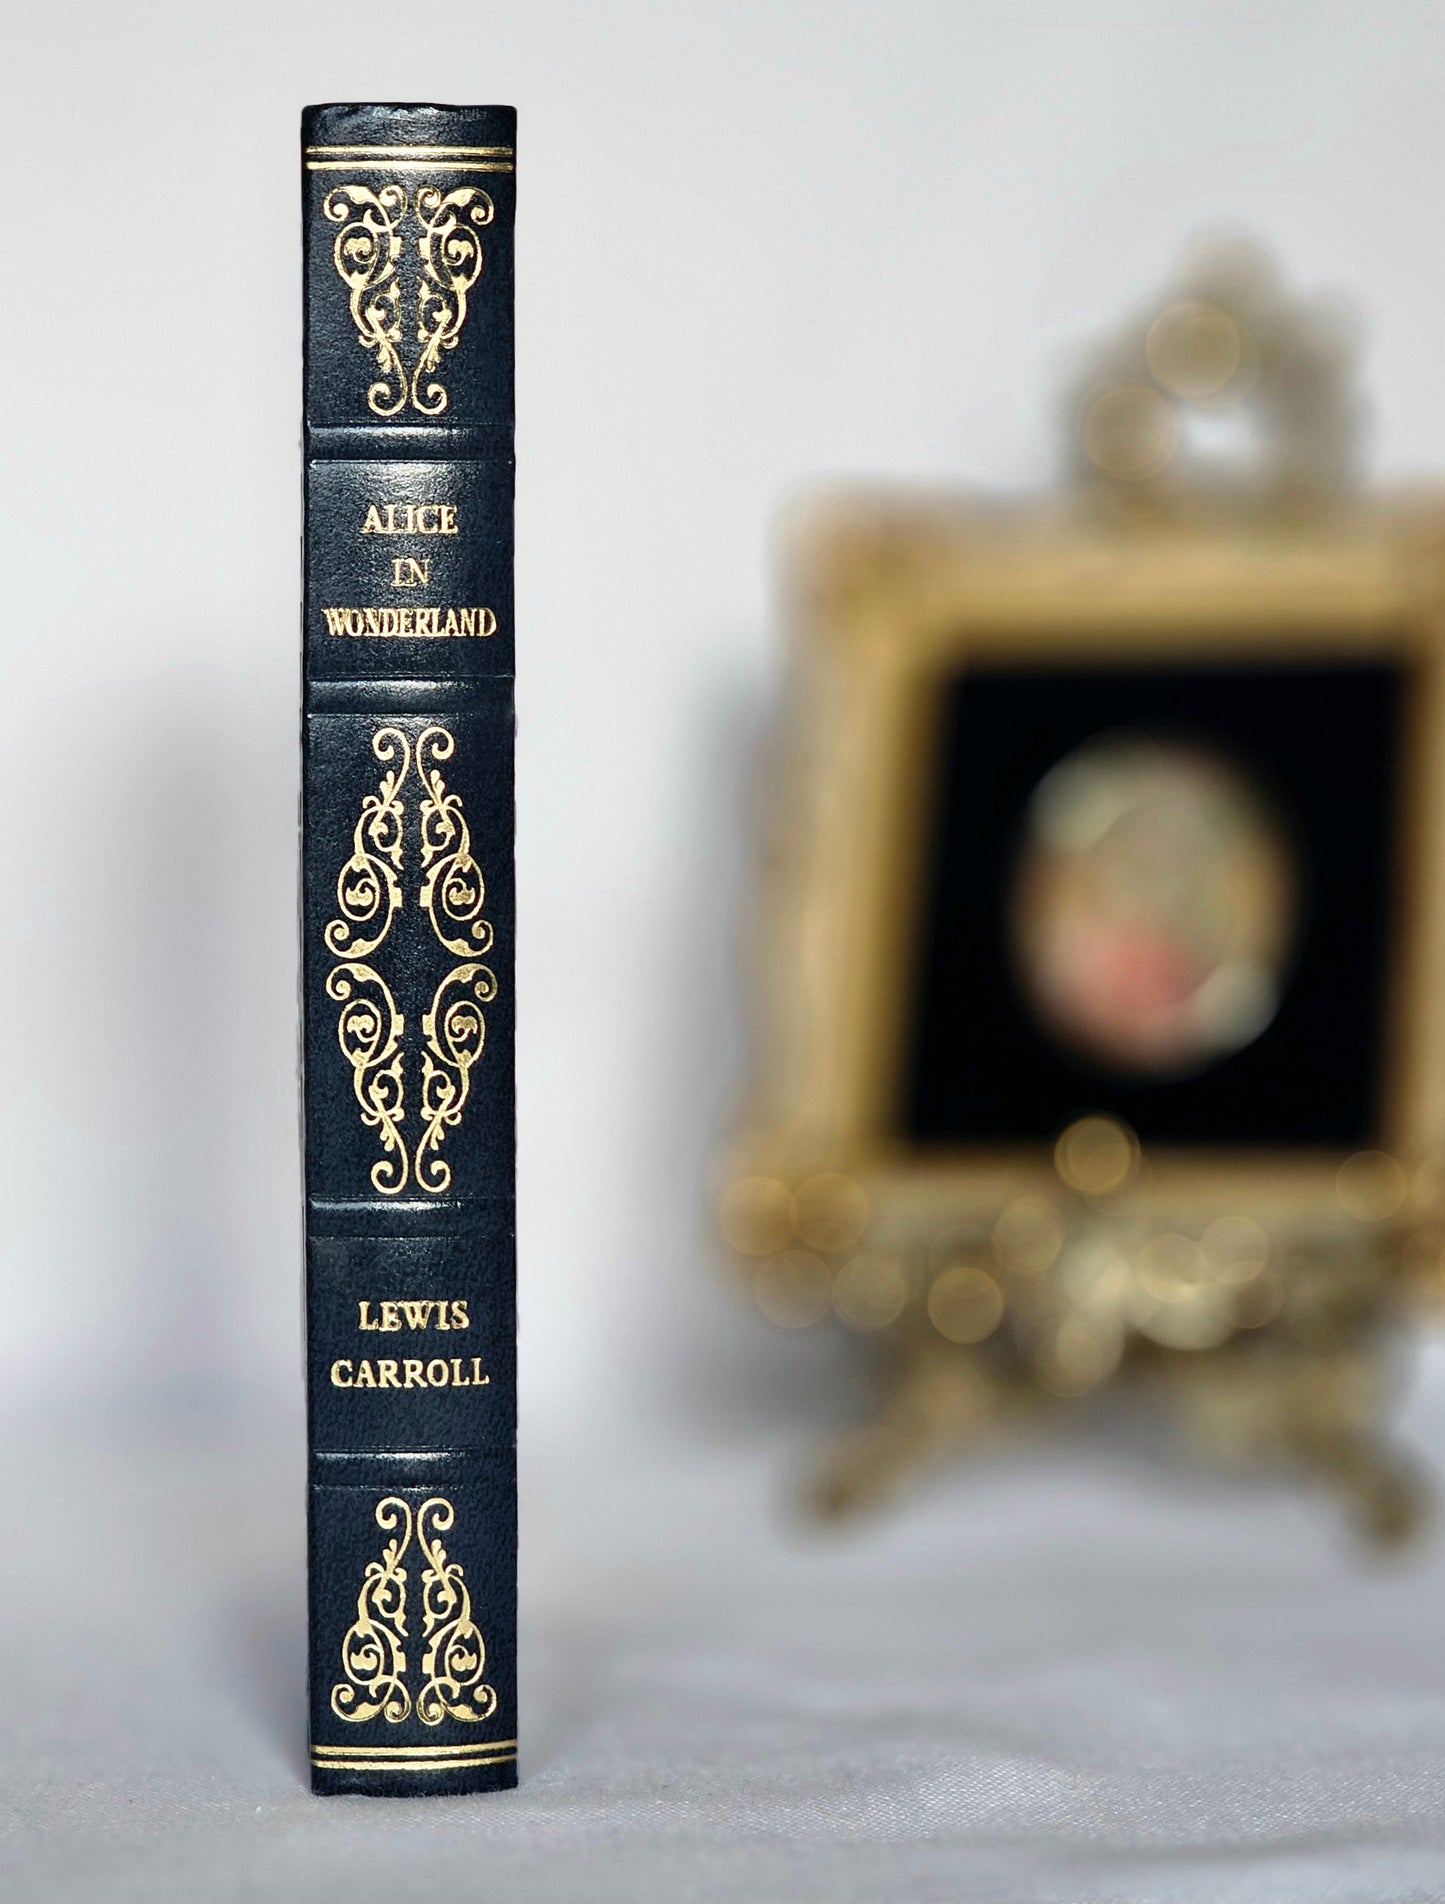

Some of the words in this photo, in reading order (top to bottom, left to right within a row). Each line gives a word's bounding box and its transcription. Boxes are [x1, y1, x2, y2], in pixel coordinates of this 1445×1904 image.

[360, 504, 459, 534] ALICE
[390, 557, 431, 587] IN
[321, 607, 497, 637] WONDERLAND
[358, 1300, 470, 1331] LEWIS
[330, 1357, 490, 1388] CARROLL
